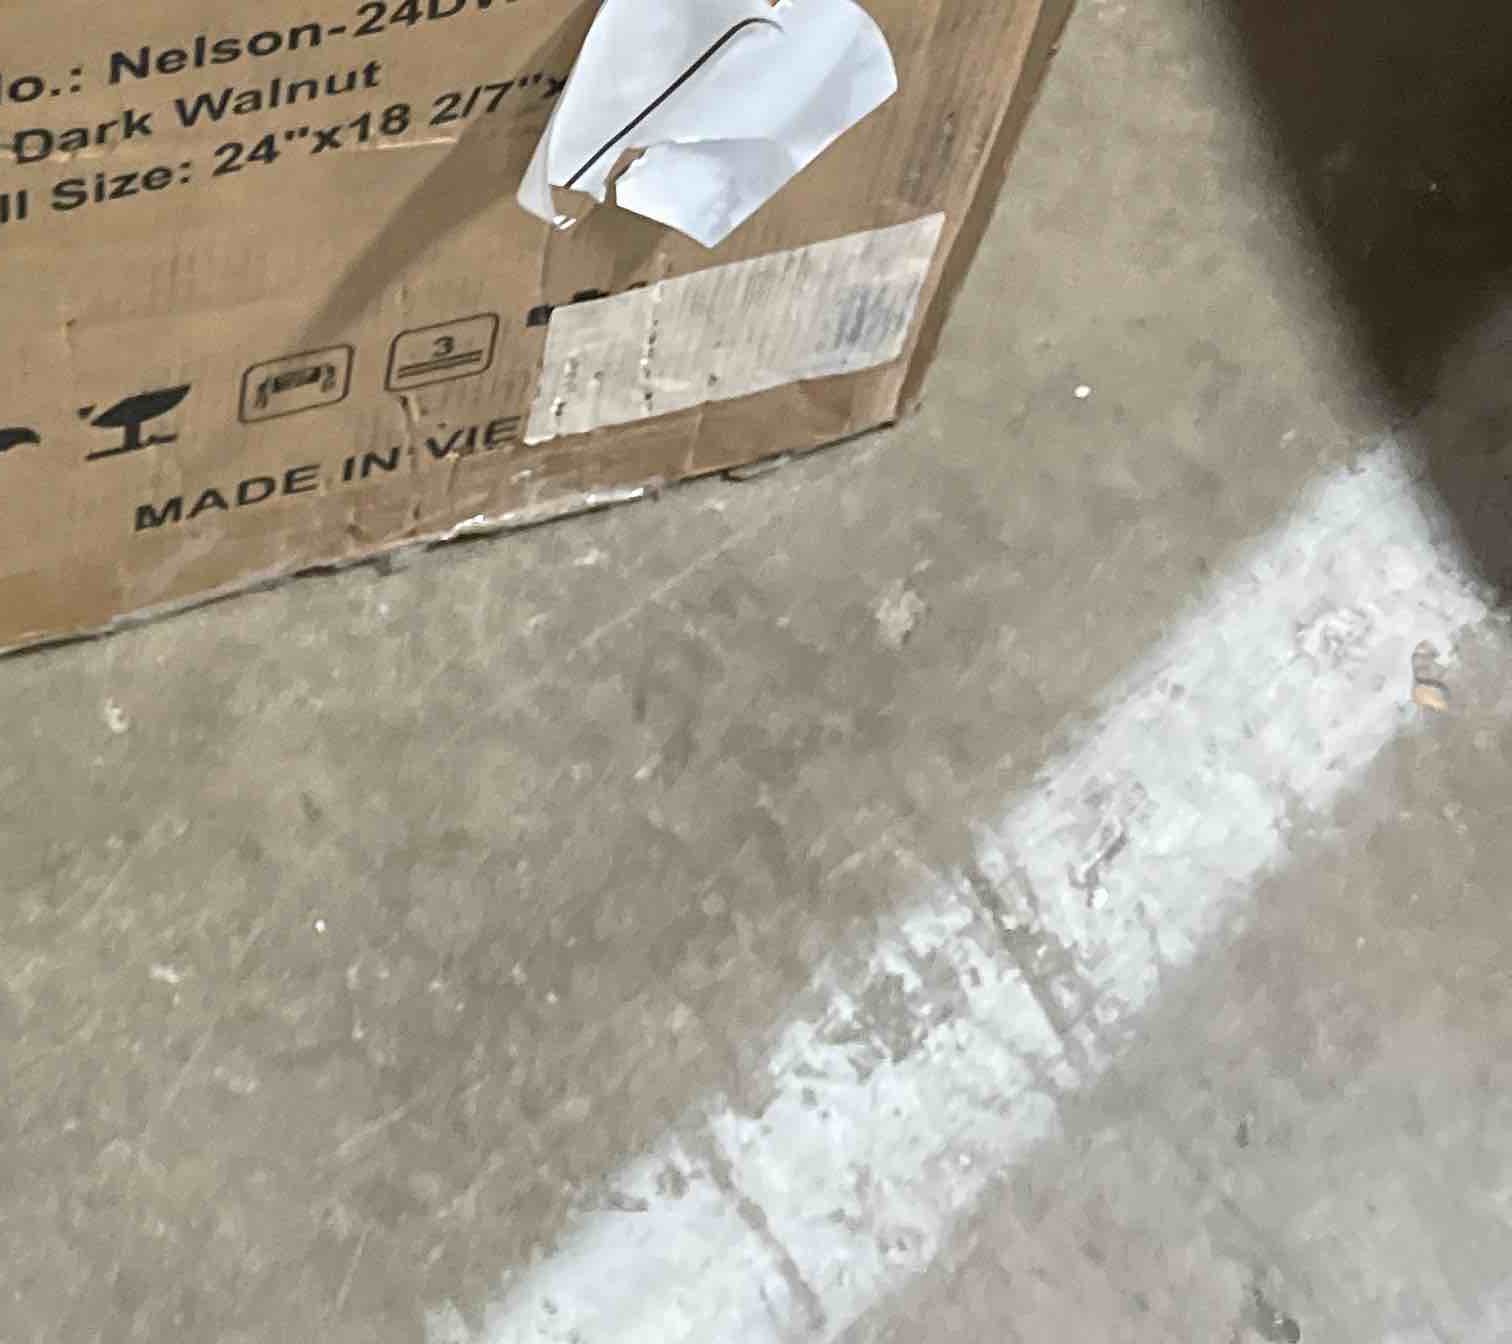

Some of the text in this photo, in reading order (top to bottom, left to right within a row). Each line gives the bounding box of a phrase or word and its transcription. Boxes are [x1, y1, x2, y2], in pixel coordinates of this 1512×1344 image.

[13, 111, 152, 166] Dark
[173, 60, 382, 131] Walnut
[51, 157, 193, 211] Size:
[212, 104, 410, 177] 24"x18
[430, 335, 456, 358] 3
[134, 464, 322, 532] MADE
[342, 447, 401, 482] IN
